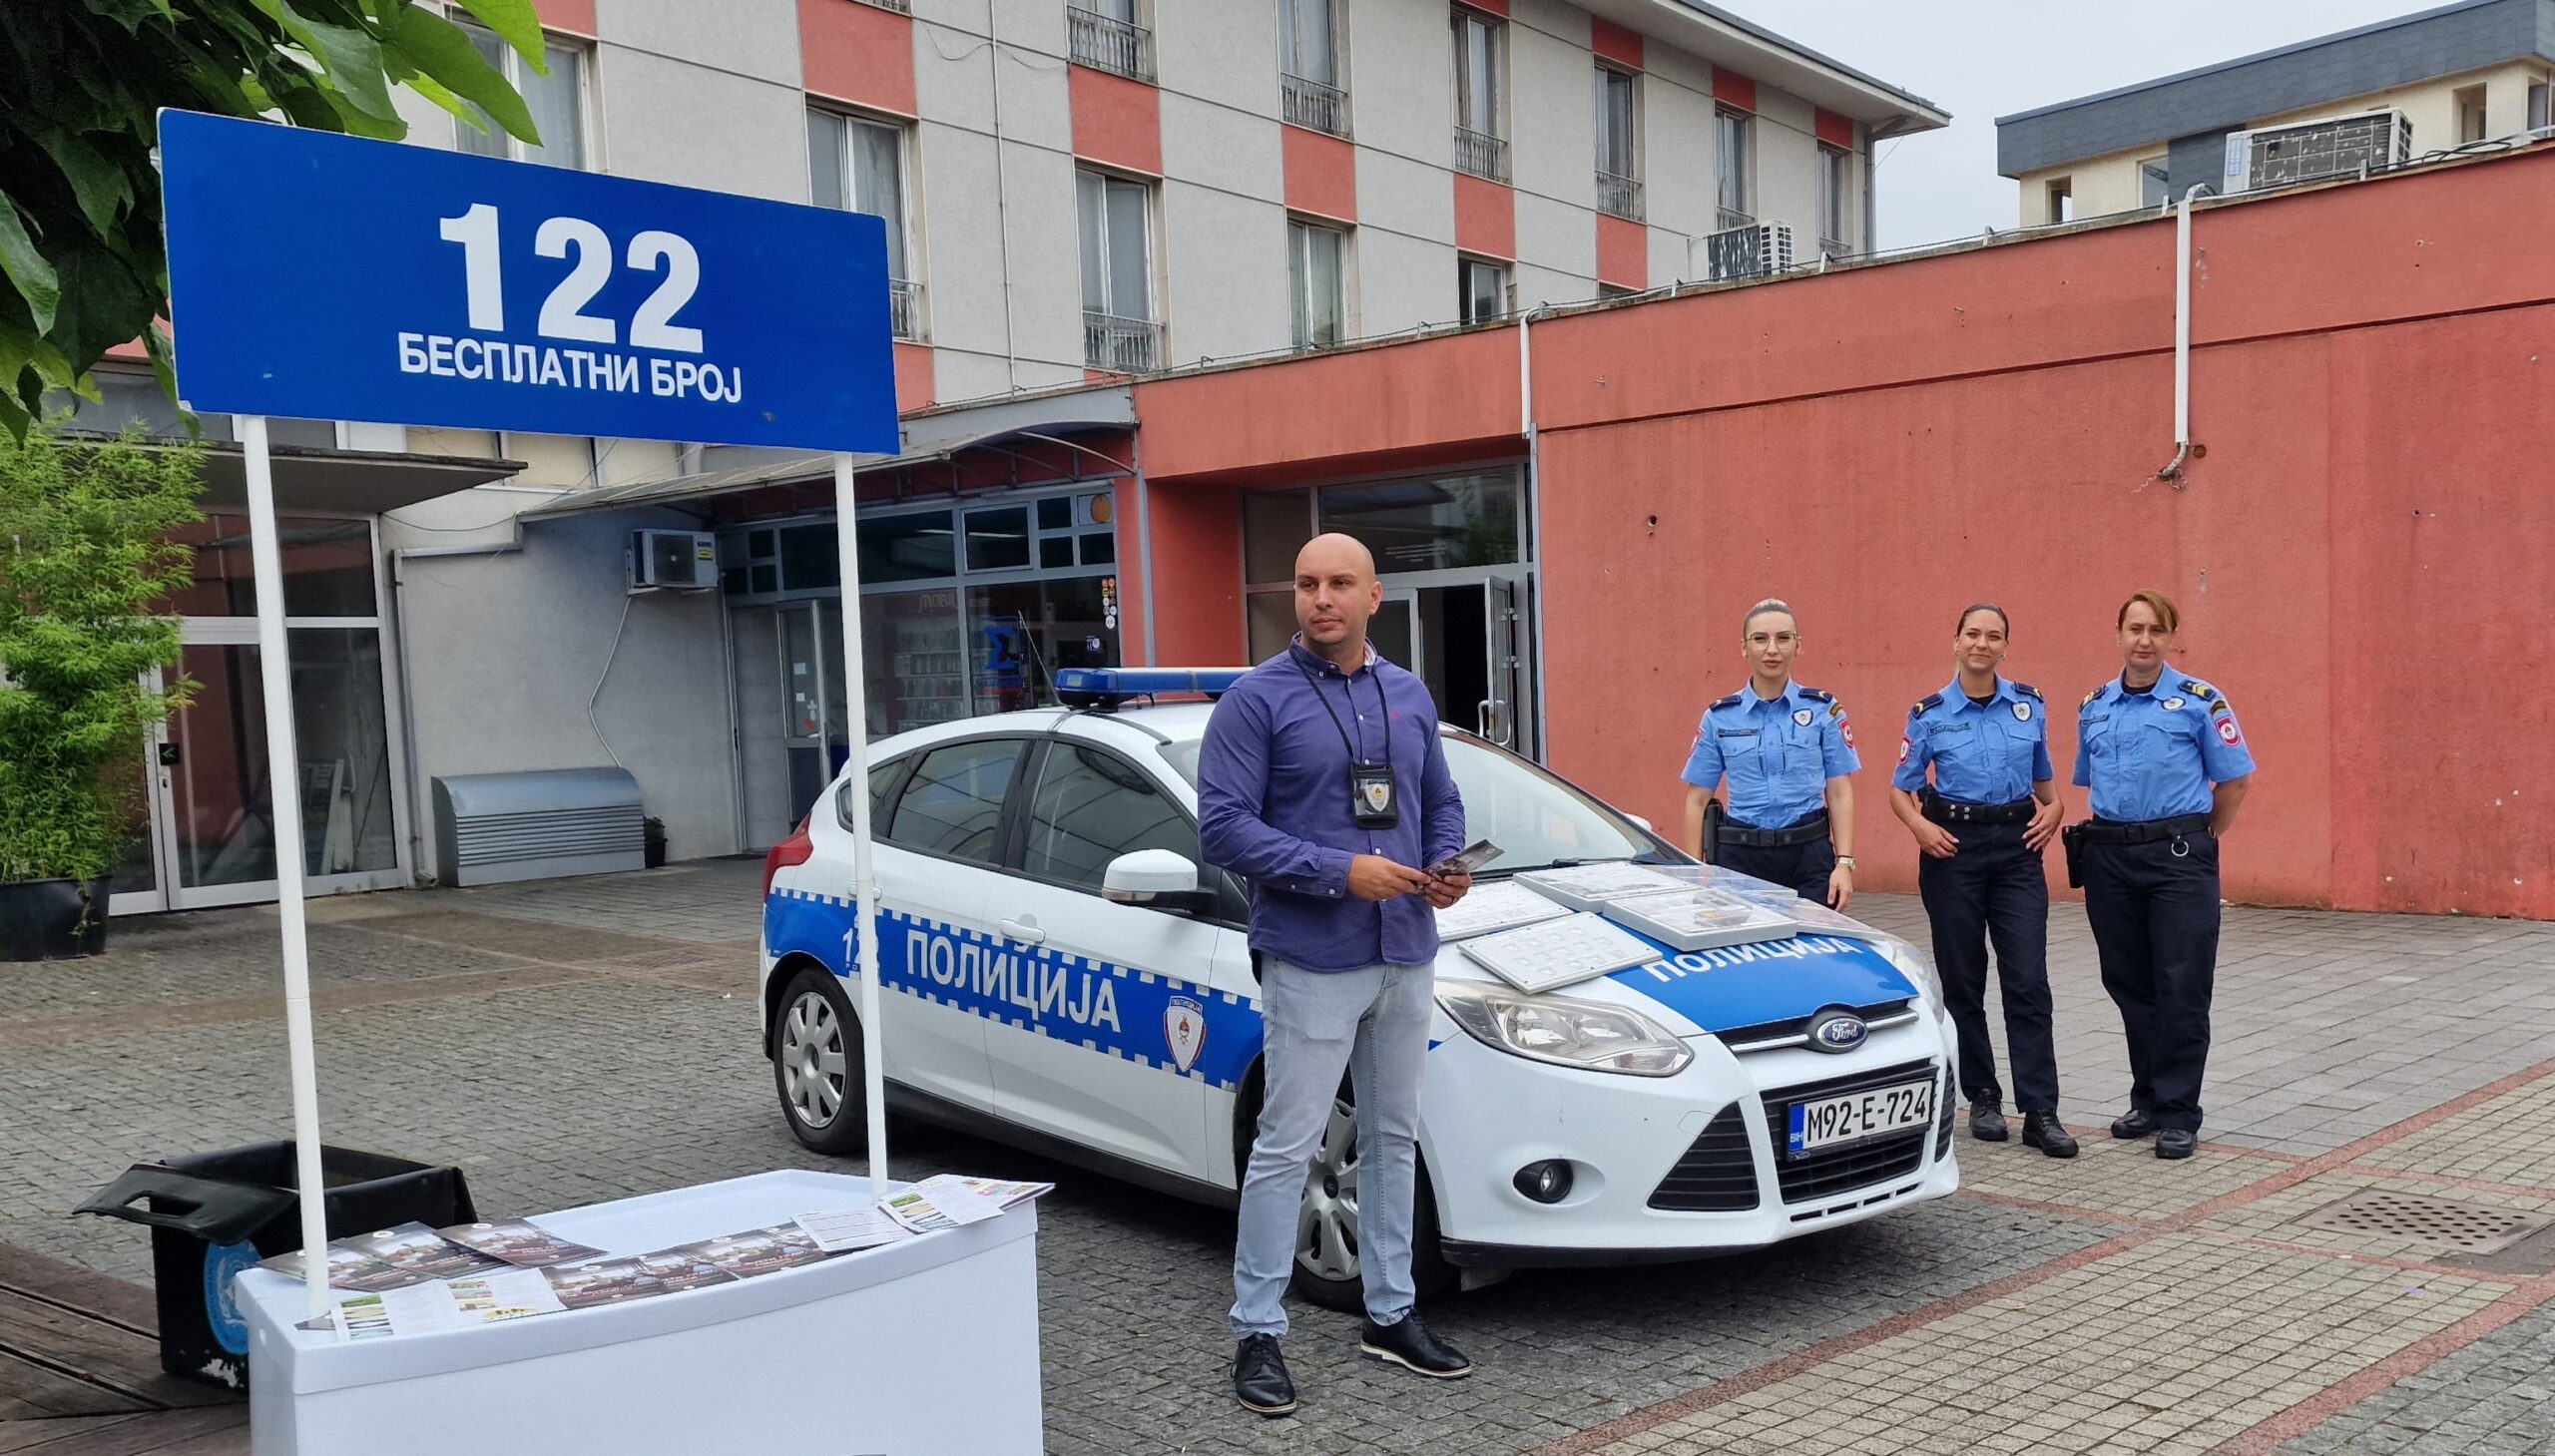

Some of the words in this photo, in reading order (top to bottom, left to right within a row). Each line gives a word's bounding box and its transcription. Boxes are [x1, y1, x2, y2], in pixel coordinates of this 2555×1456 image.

[440, 203, 704, 353] 122
[399, 332, 640, 394] БЕСПЛАТНИ
[652, 359, 743, 403] БРОЈ
[907, 929, 1121, 1033] ПОЛИЦИЈА
[1643, 937, 1862, 982] ПОЛИЦИЈА
[1831, 1022, 1858, 1041] Ford
[1807, 1087, 1926, 1142] M92-E-724
